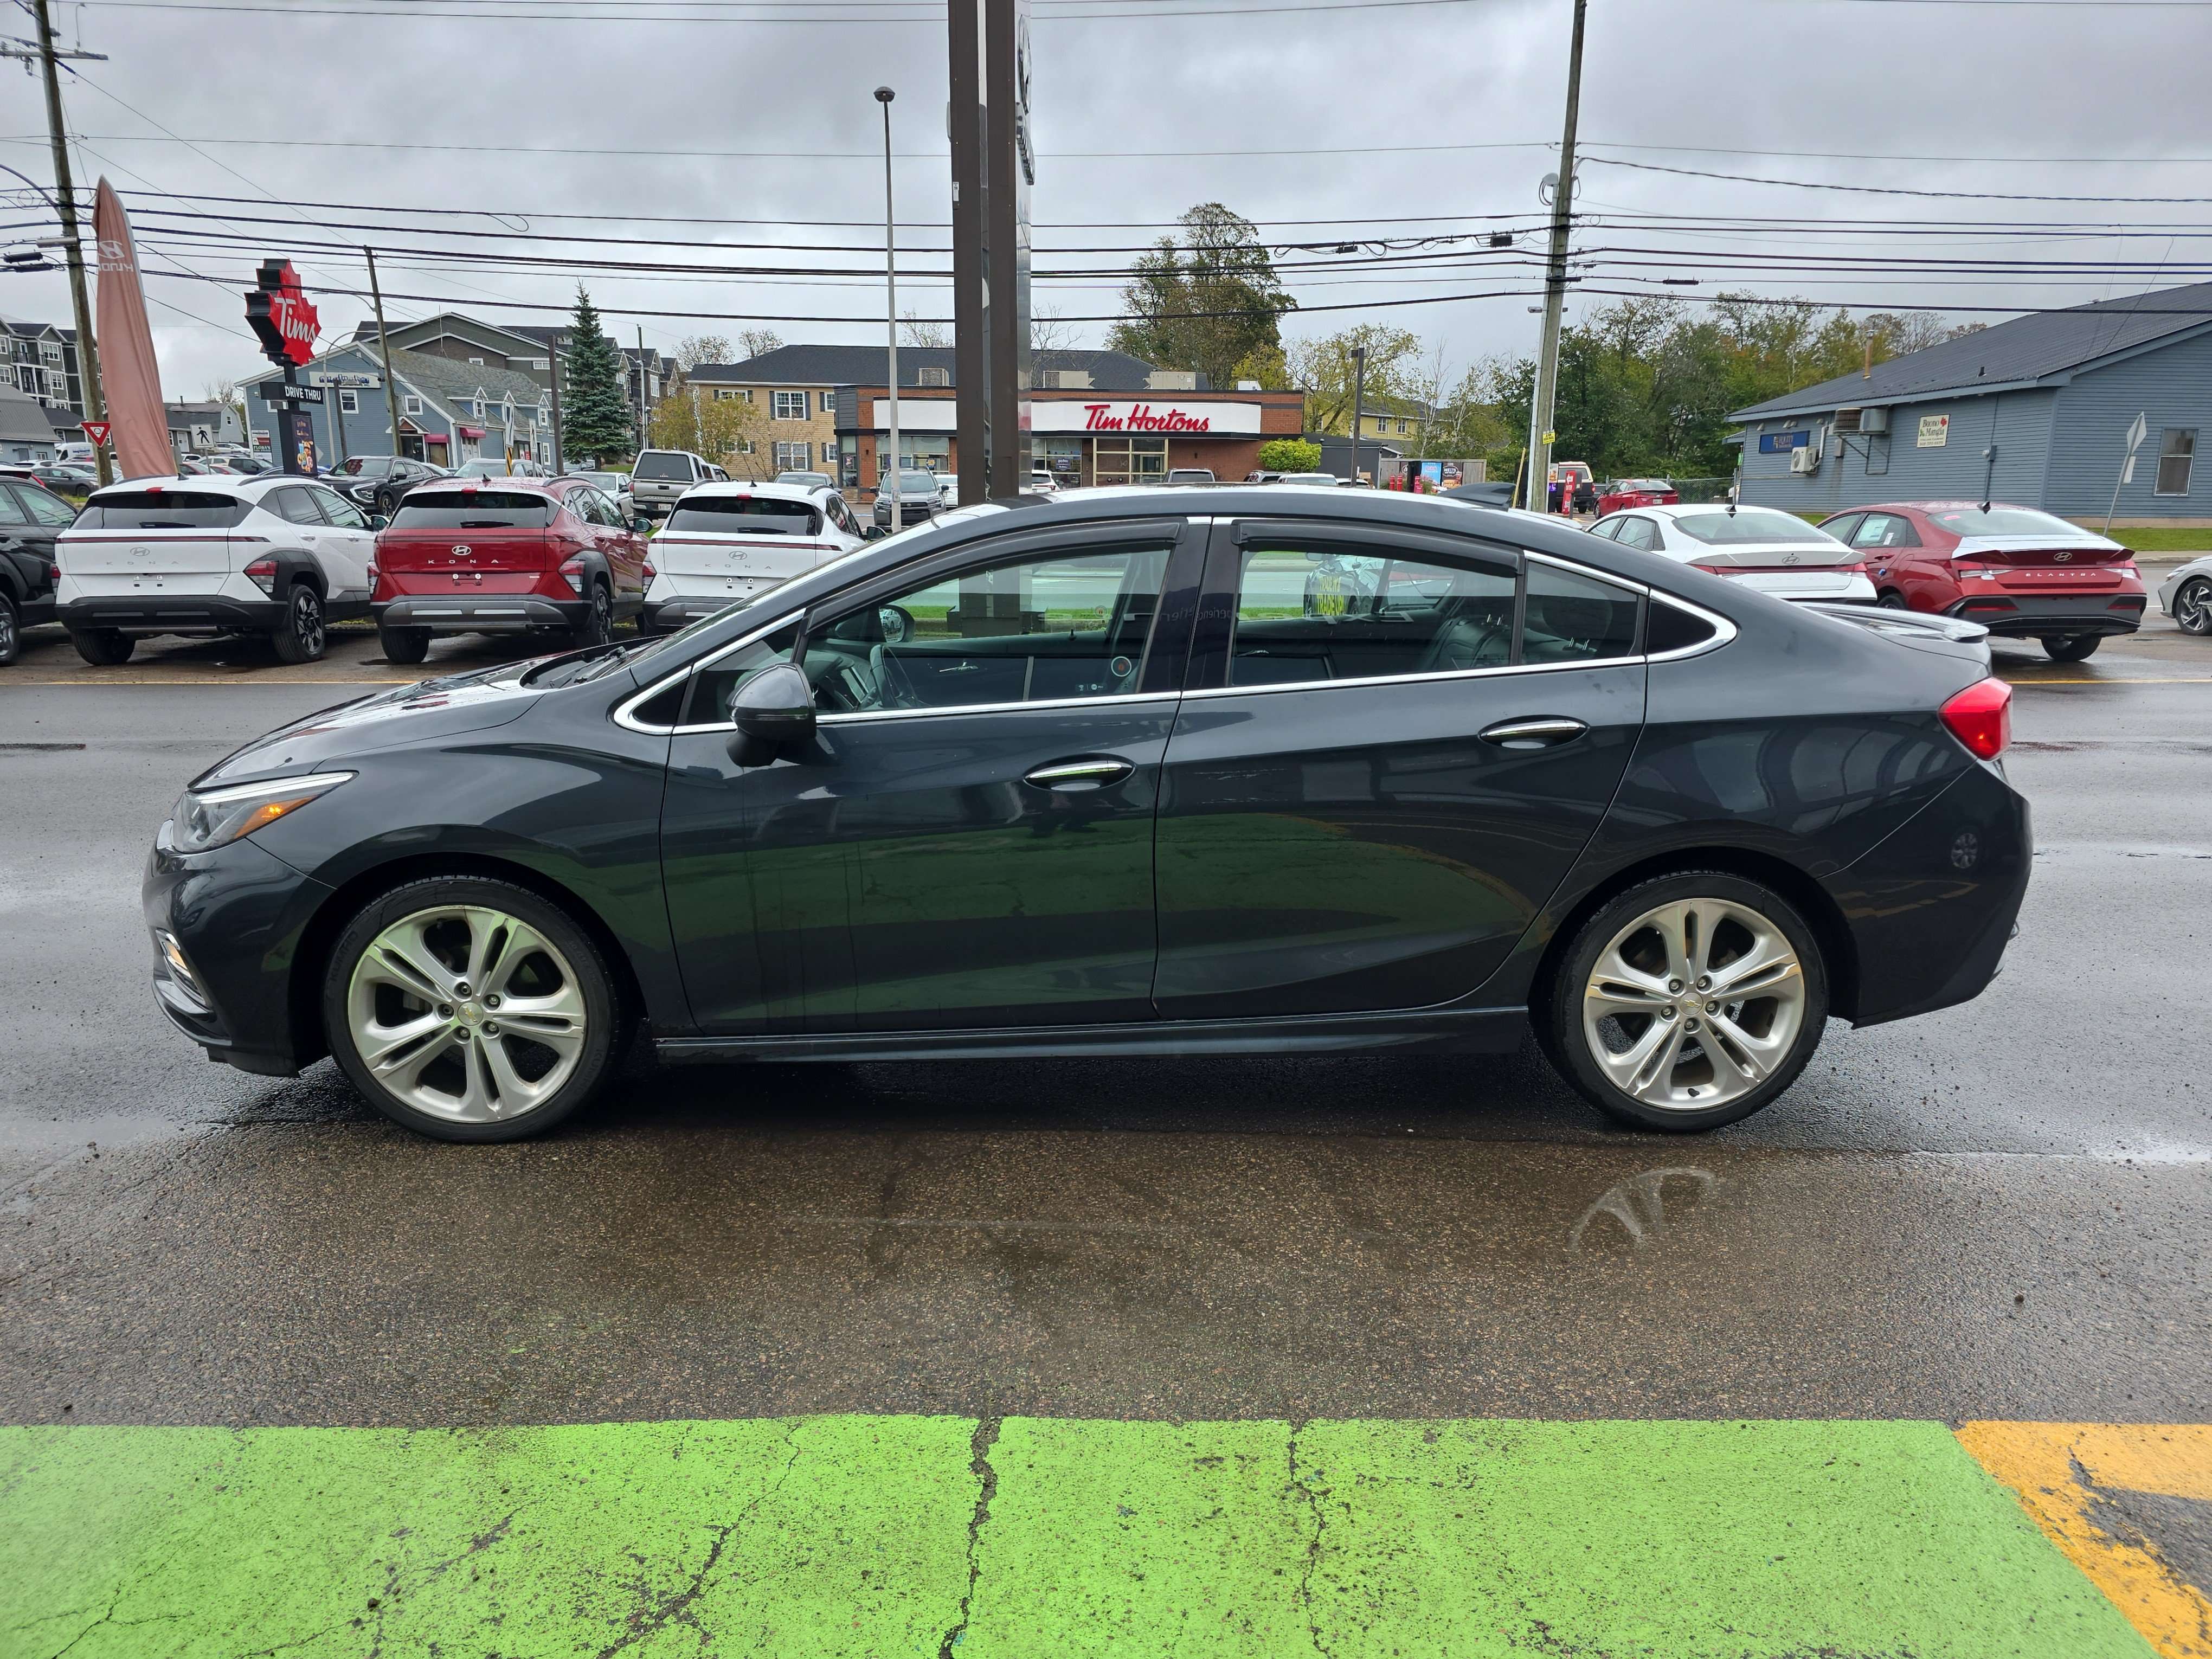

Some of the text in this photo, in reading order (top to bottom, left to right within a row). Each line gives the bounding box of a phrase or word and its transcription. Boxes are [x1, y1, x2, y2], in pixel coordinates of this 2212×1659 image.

[274, 297, 316, 343] Tims
[285, 385, 321, 401] DRIVE THRU
[1084, 403, 1210, 432] Tim Hortons
[1316, 594, 1335, 616] TRADE
